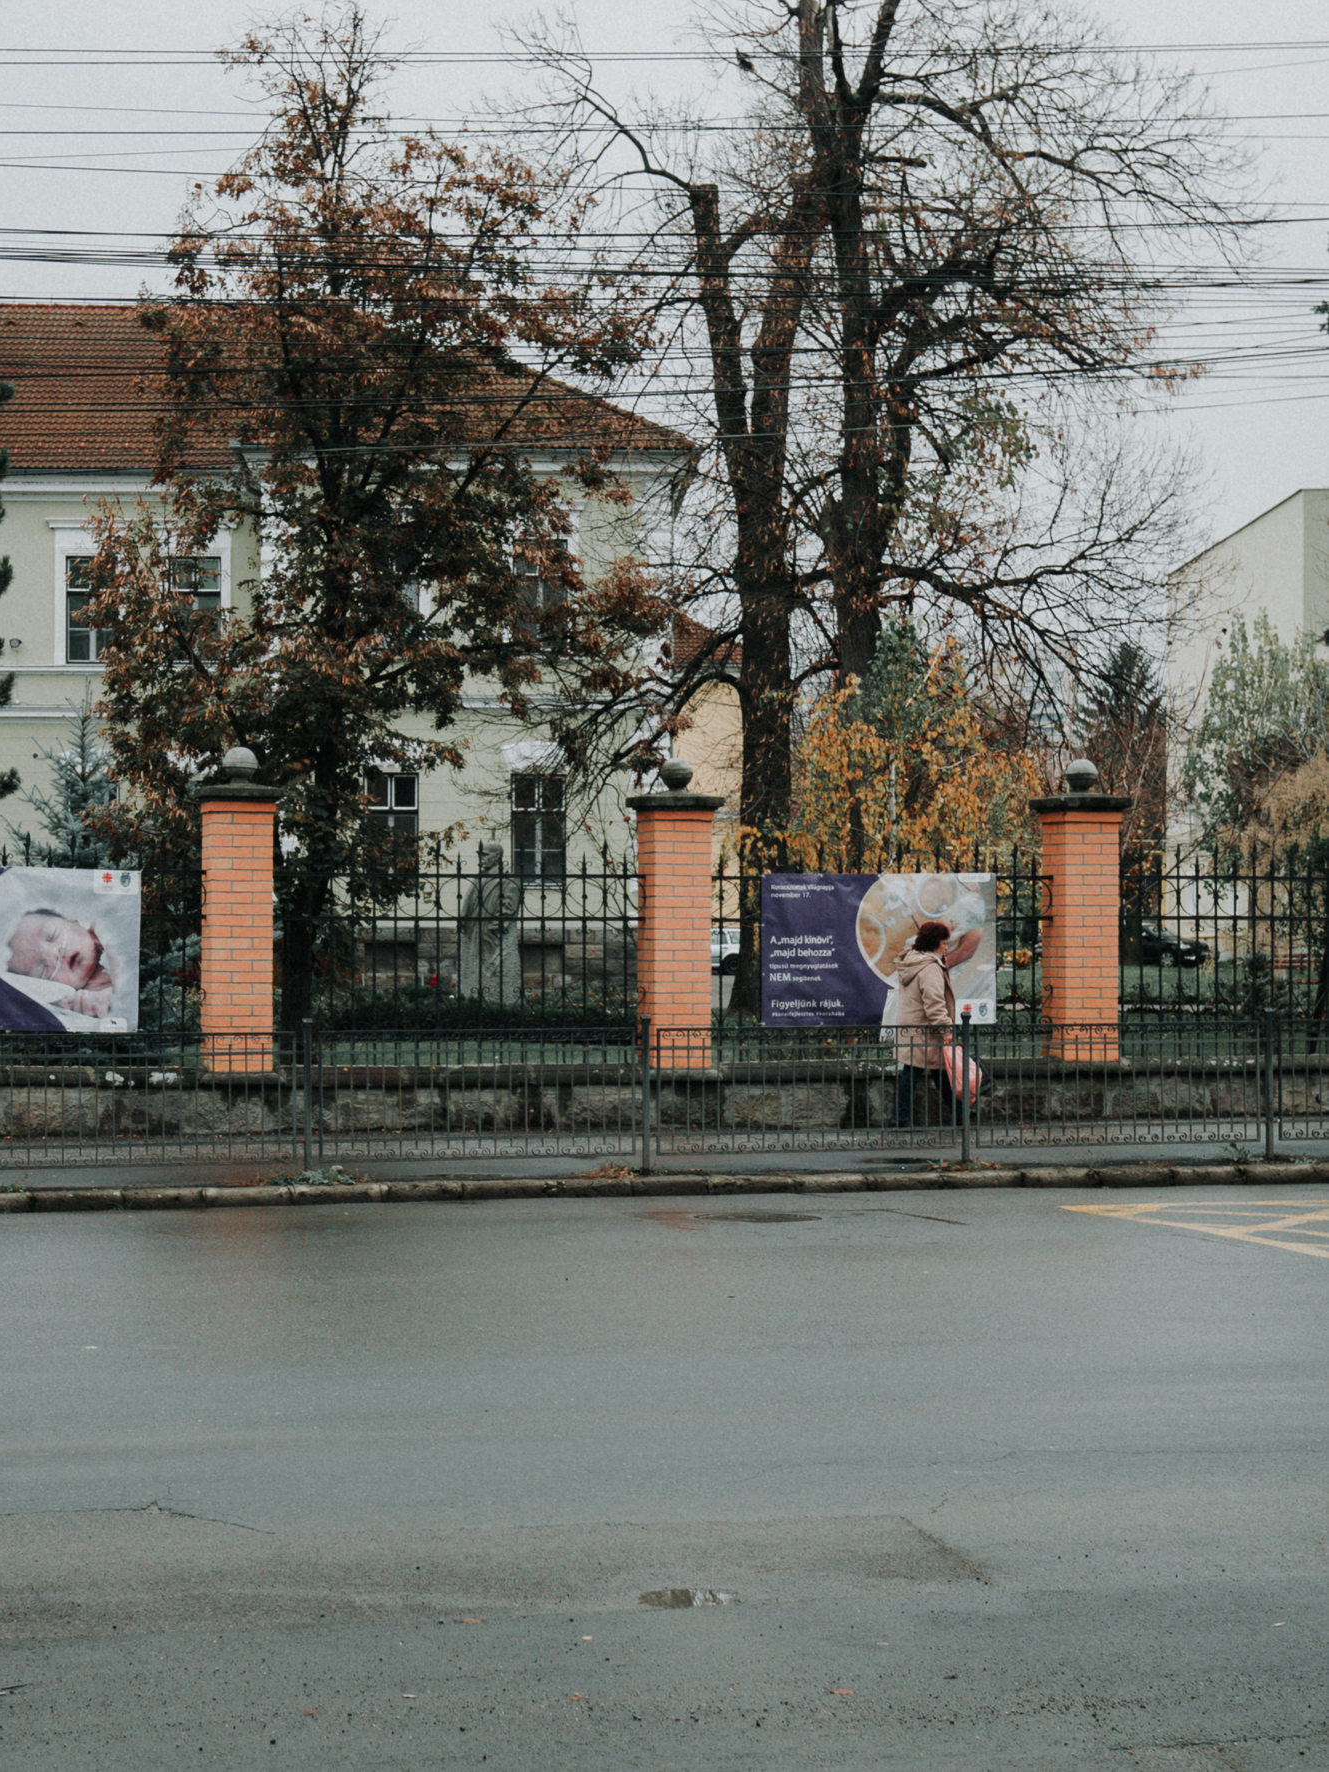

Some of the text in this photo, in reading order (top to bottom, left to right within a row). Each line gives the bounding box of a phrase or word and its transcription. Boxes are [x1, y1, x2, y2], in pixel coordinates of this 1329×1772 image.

[771, 891, 811, 899] november 17.
[769, 972, 791, 982] NEM
[771, 999, 845, 1010] Figyeljünk rájuk.
